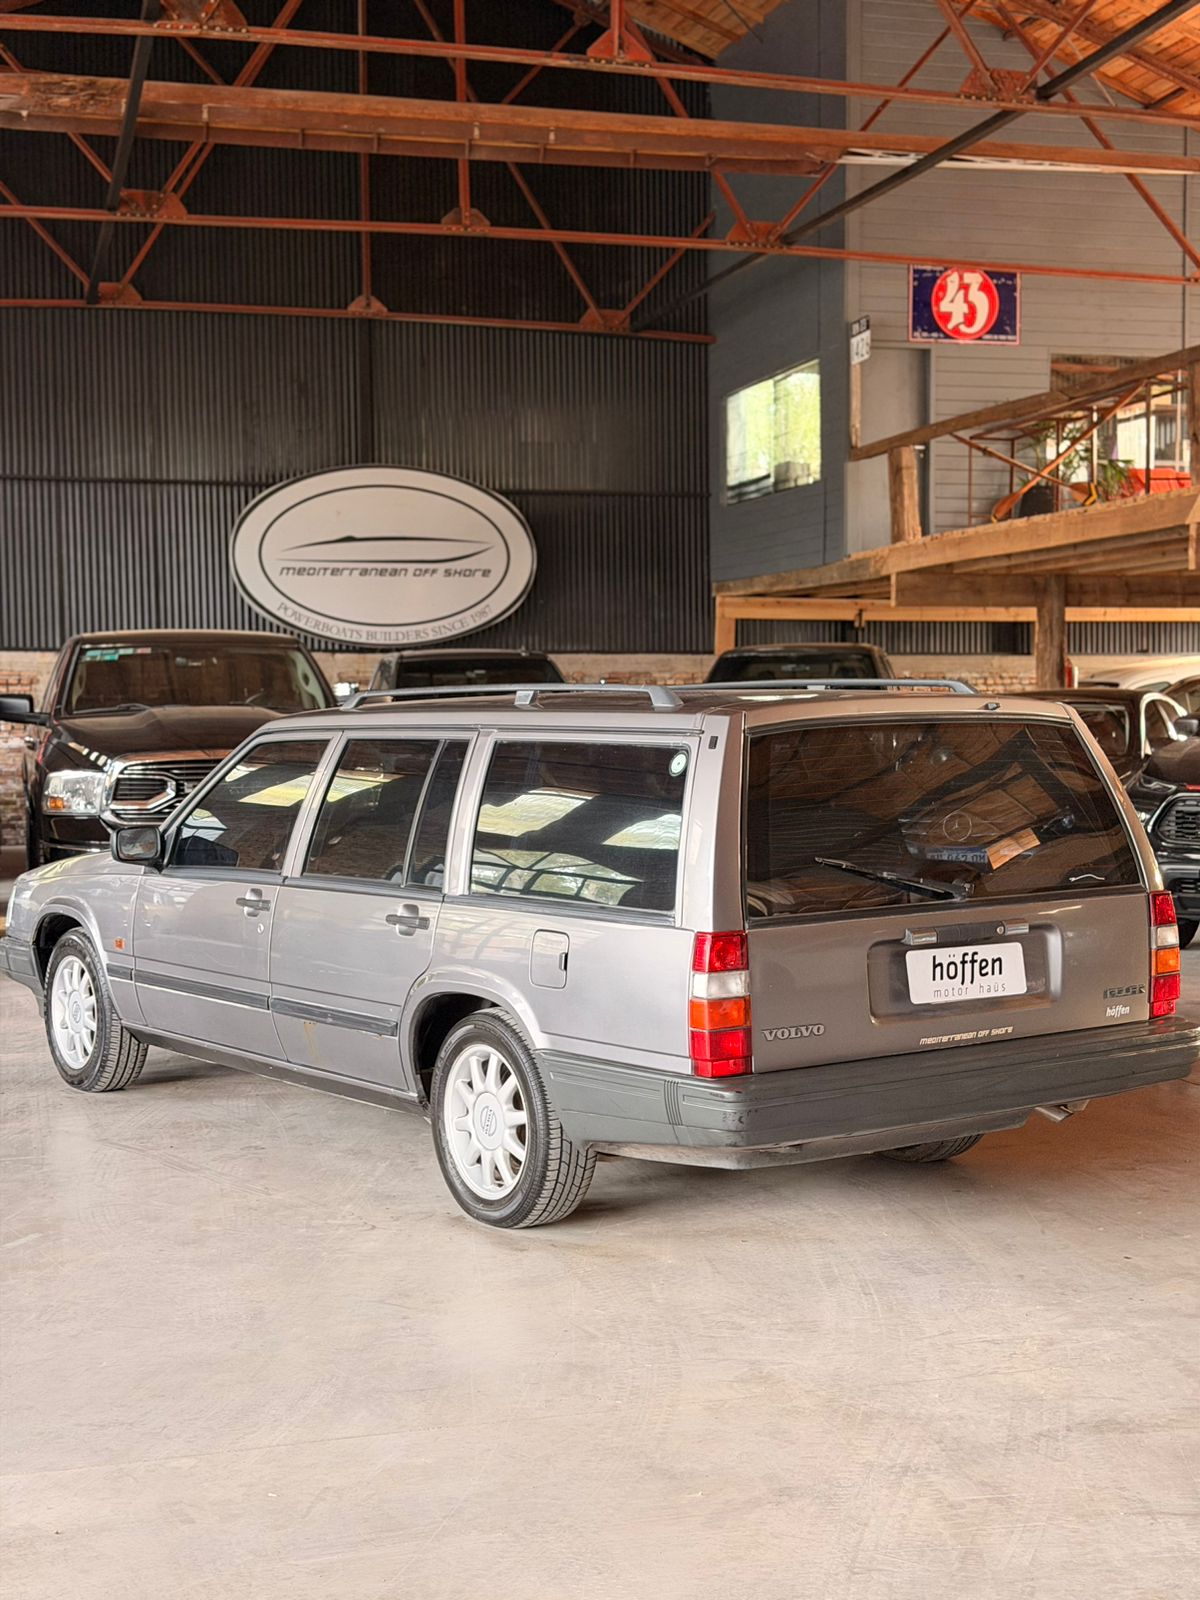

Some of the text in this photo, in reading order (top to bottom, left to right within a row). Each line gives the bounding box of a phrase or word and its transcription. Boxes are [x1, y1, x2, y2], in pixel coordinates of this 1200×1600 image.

[939, 271, 990, 334] 43
[412, 567, 439, 578] OFF
[277, 602, 494, 641] POWERBOATS BUILDERS SINCE 1987
[932, 951, 1003, 985] höffen
[933, 986, 969, 998] motor
[761, 1024, 825, 1041] VOLVO
